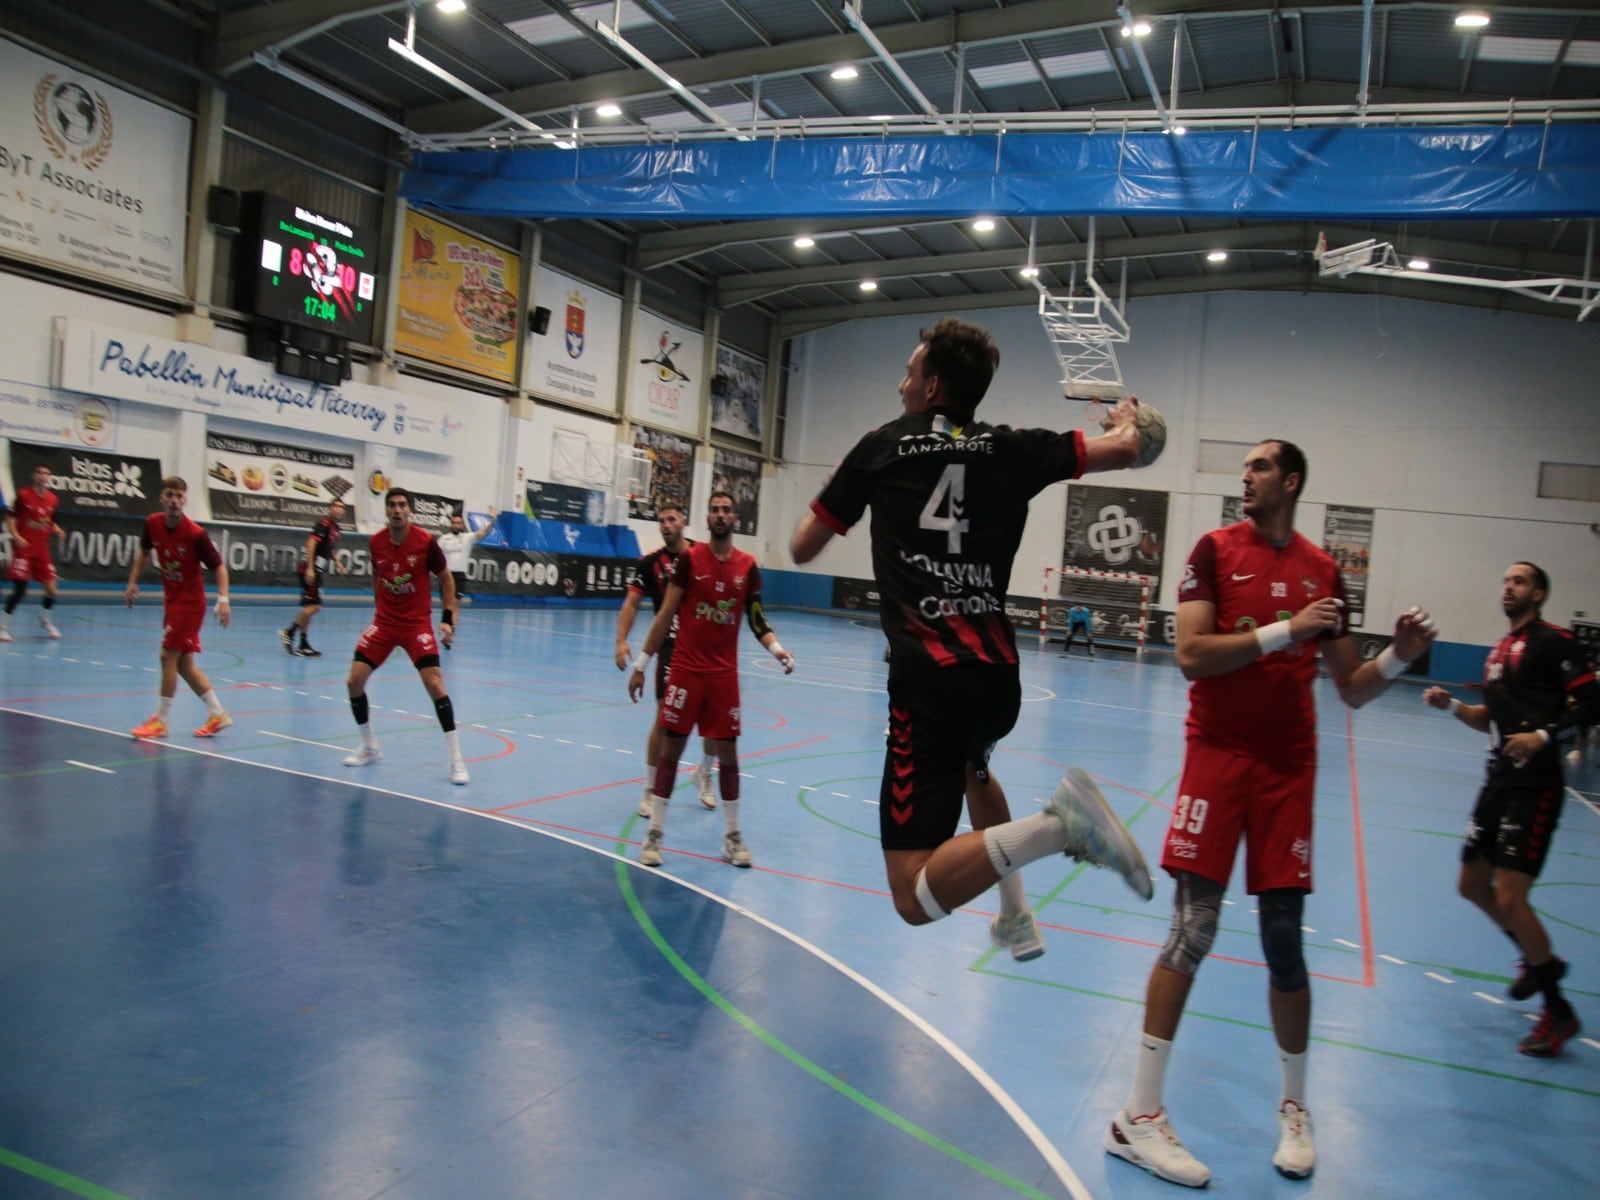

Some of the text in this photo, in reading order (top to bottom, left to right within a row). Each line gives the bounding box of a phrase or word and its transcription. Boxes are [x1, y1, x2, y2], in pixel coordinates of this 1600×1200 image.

[40, 162, 143, 214] Associates
[289, 248, 303, 275] 8
[304, 297, 337, 321] 17:04
[100, 339, 206, 388] Pabellón
[212, 365, 317, 414] Municipal
[319, 384, 387, 432] Titerroy
[898, 440, 993, 456] LANZAROTE
[71, 456, 113, 478] Islas
[46, 475, 116, 497] anarias
[919, 464, 969, 554] 4
[665, 684, 687, 709] 33
[1172, 795, 1209, 834] 39
